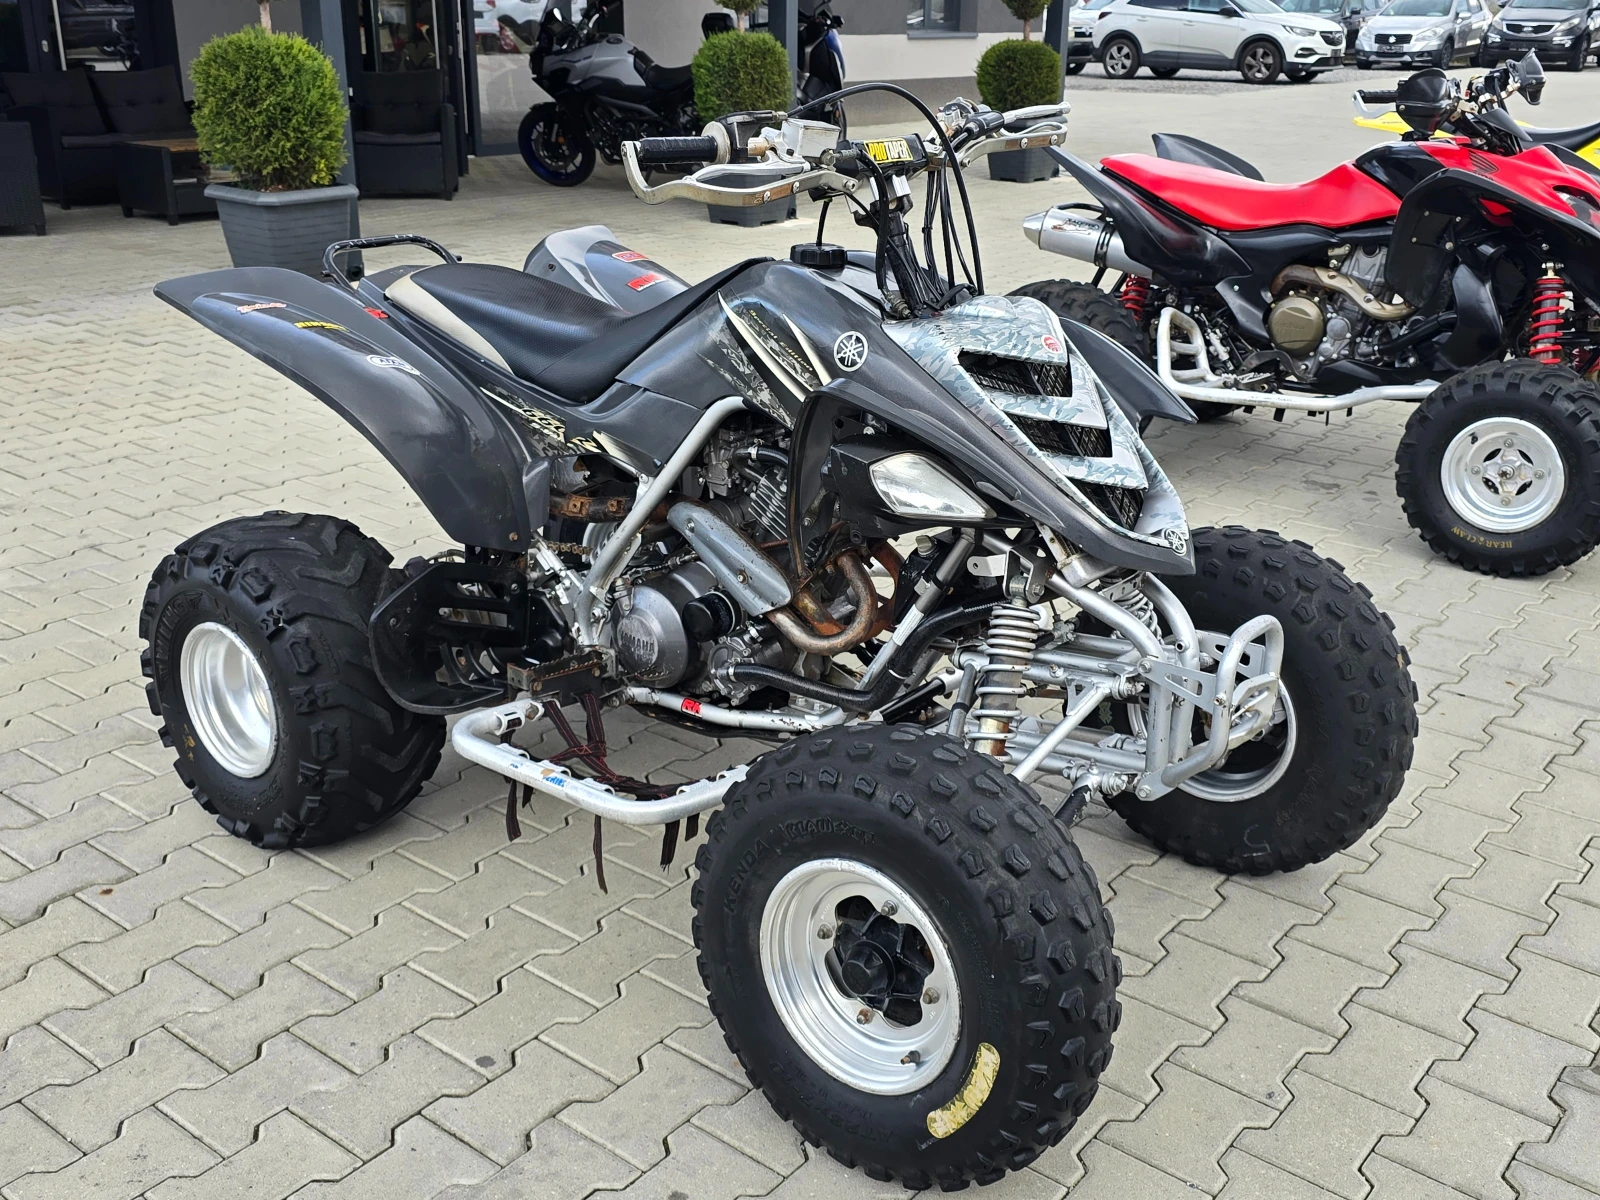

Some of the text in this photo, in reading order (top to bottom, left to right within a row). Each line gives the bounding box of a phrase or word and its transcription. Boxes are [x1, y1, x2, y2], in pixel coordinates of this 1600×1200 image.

[1450, 525, 1513, 549] BEAR CLAW
[723, 837, 770, 914] KENDA
